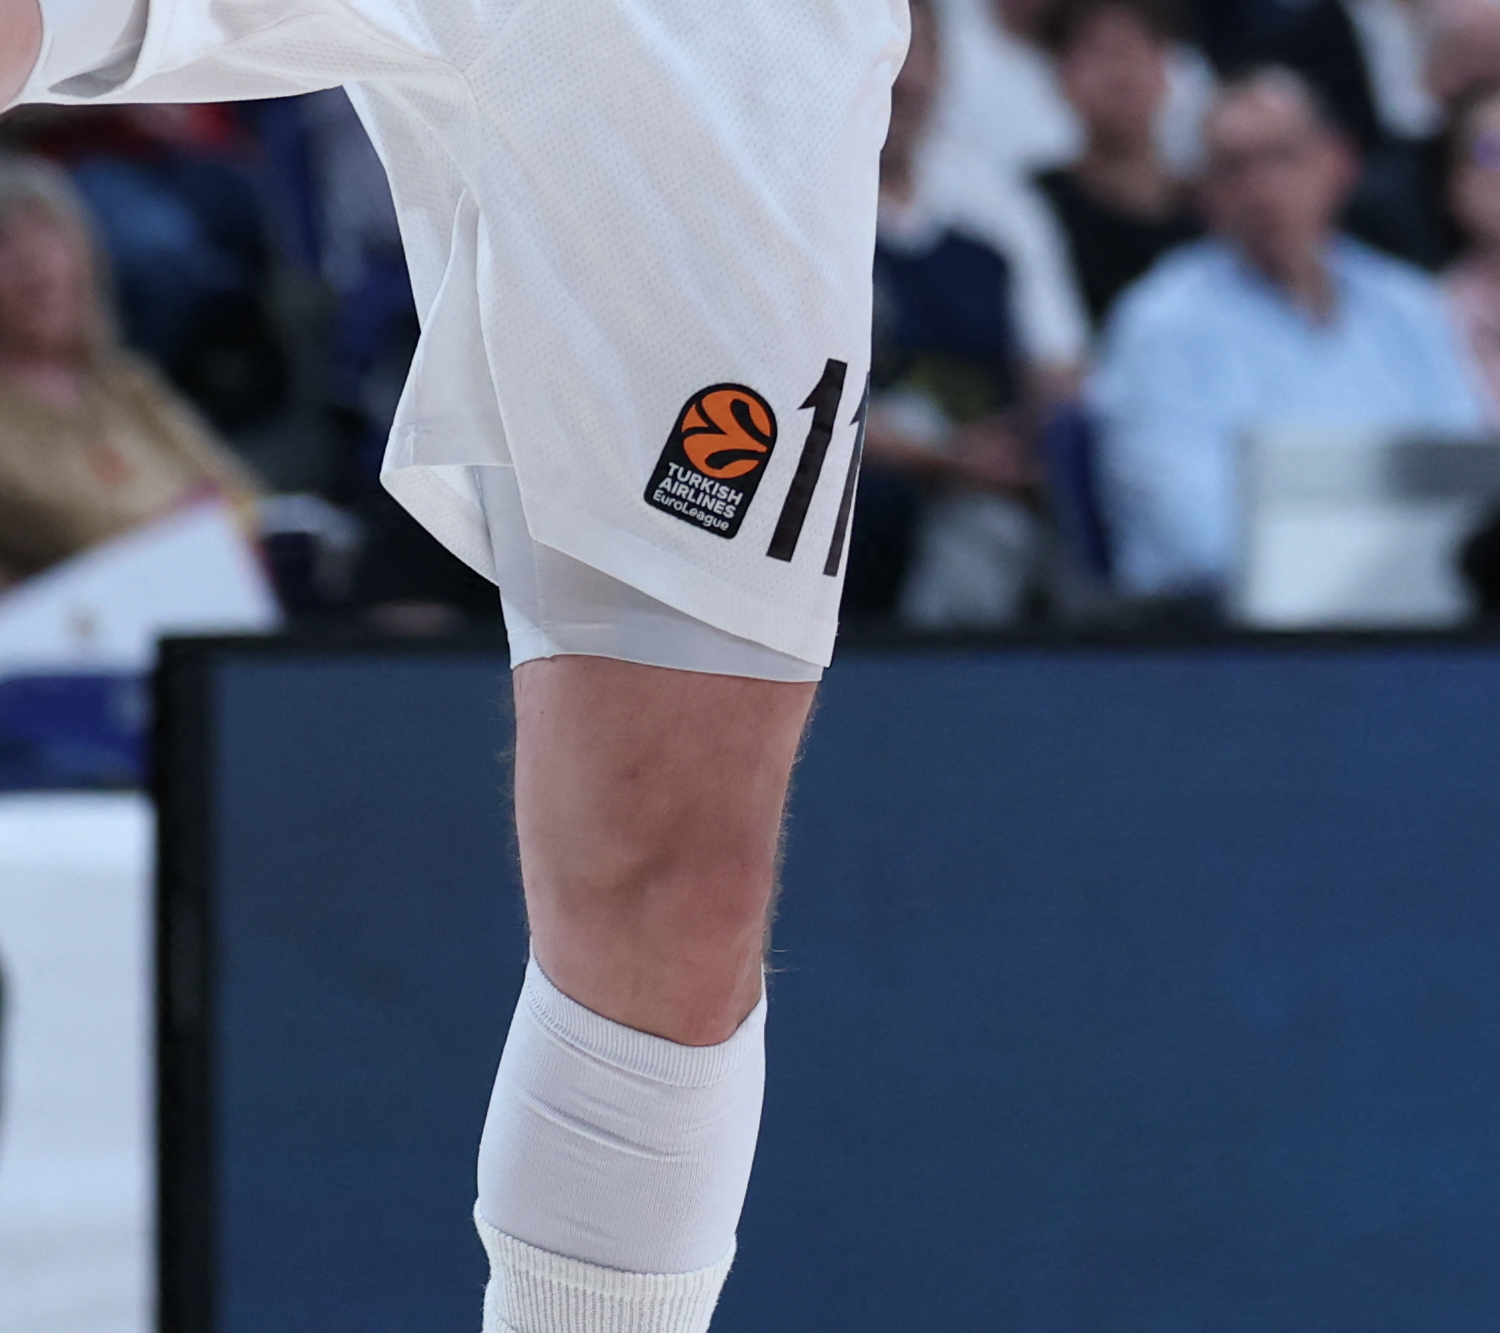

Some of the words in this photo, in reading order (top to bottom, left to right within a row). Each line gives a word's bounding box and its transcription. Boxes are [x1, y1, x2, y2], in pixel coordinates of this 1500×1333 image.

[658, 477, 737, 519] AIRLINES
[668, 461, 744, 506] TURKISH
[652, 489, 730, 531] EuroLeague
